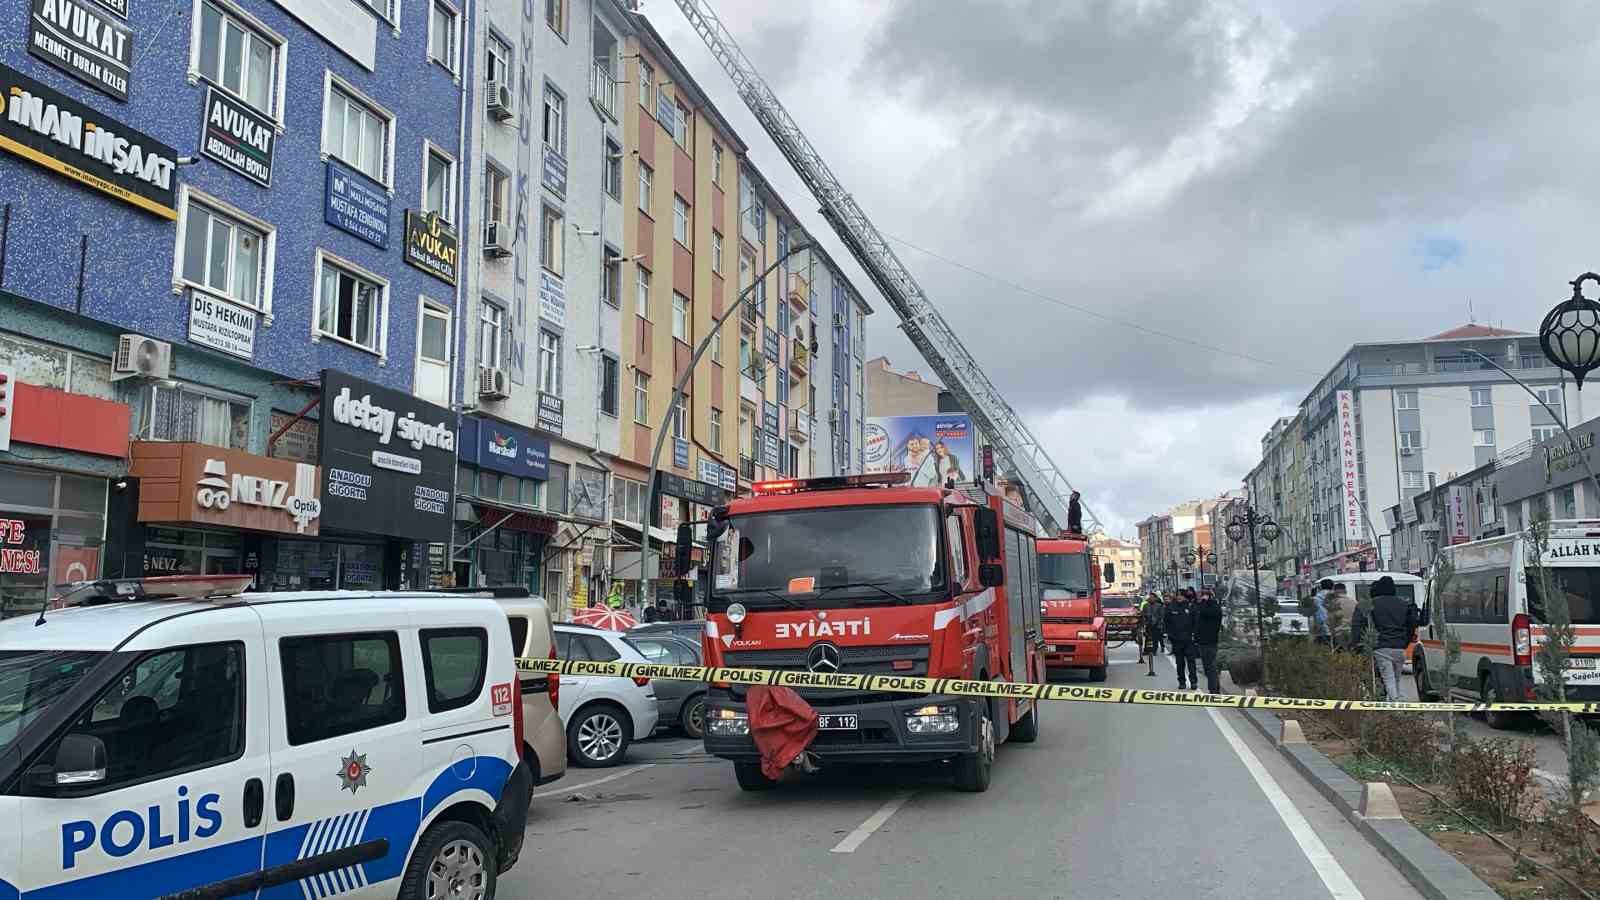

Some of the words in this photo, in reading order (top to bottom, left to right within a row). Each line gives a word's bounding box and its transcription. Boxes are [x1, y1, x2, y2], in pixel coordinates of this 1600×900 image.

[42, 0, 127, 61] AVUKAT
[34, 31, 72, 62] MEHMET
[73, 53, 102, 80] BURAK
[102, 67, 128, 93] ÖZLER
[210, 100, 271, 153] AVUKAT
[207, 137, 246, 168] ABDULLAH
[245, 157, 269, 180] BOYLU
[331, 196, 358, 220] MUSTAFA
[410, 227, 456, 265] AVUKAT
[193, 317, 217, 332] MUSTAFA
[194, 296, 213, 319] DİŞ
[215, 304, 253, 331] HEKİMİ
[333, 387, 396, 444] detay
[396, 412, 454, 451] sigorta
[1341, 392, 1353, 457] KARAMAN
[328, 481, 367, 500] SİGORTA
[329, 468, 372, 487] ANADOLU
[415, 486, 449, 502] ANADOLU
[294, 498, 318, 513] Optik
[414, 498, 445, 514] SİGORTA
[493, 687, 510, 702] 112
[577, 662, 616, 674] POLİS
[636, 665, 701, 679] GİRİLMEZ
[720, 669, 763, 681] POLİS
[784, 673, 858, 687] GİRİLMEZ
[878, 678, 926, 690] POLİS
[951, 681, 1034, 695] GİRİLMEZ
[1057, 687, 1113, 698] POLİS
[1142, 691, 1236, 704] GİRİLMEZ
[838, 716, 856, 728] 112
[61, 785, 223, 870] POLİS
